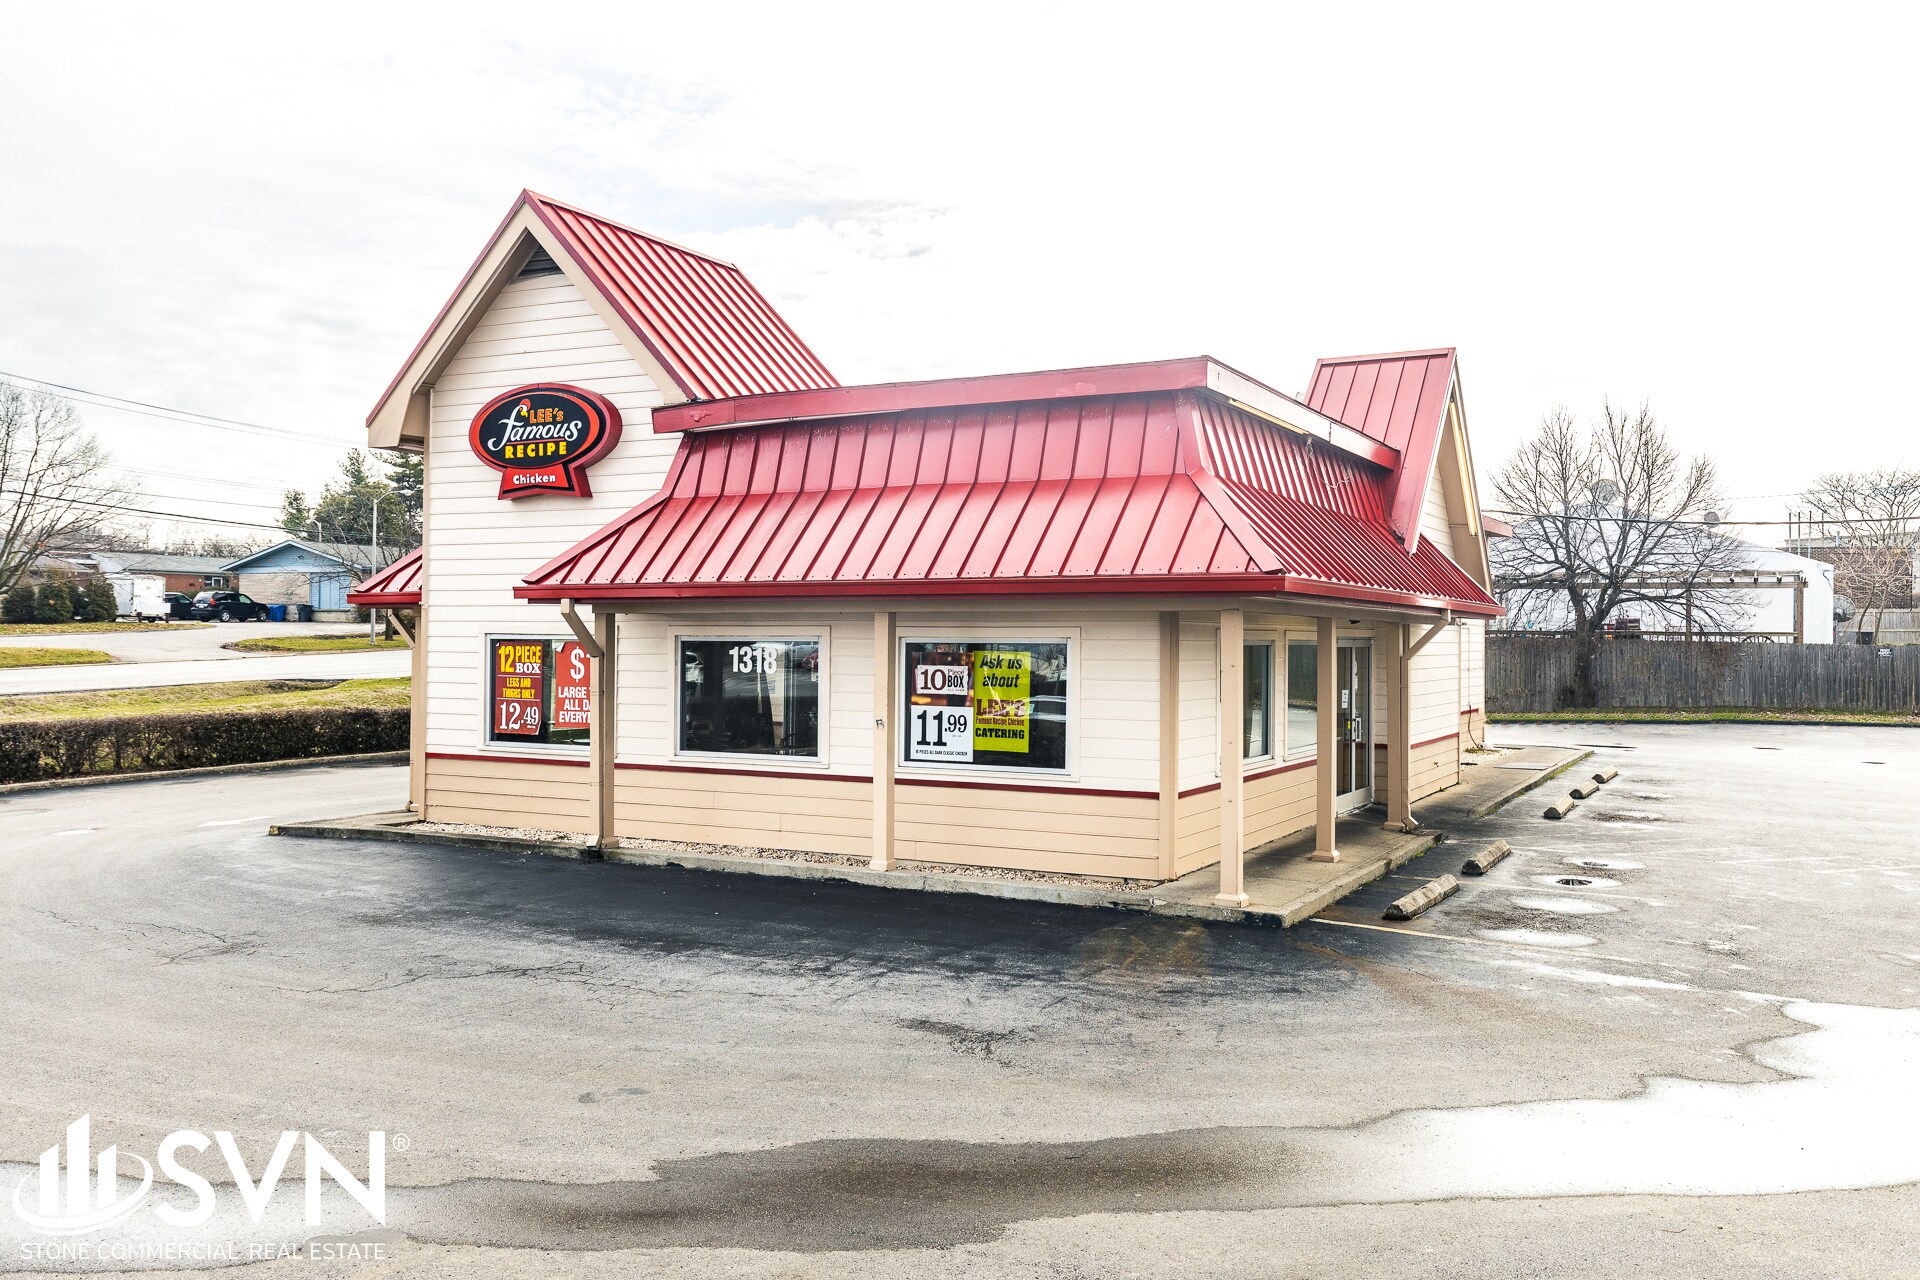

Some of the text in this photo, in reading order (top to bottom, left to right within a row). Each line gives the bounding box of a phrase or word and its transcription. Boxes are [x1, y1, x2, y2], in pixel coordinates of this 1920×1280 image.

[505, 442, 567, 459] RECIPE
[513, 473, 556, 485] Chicken
[498, 645, 542, 673] 12 PIECE
[729, 645, 777, 674] 1318
[979, 654, 1023, 670] Ask us
[515, 662, 541, 674] BOX
[506, 677, 532, 688] LEGS AND
[920, 669, 947, 691] 10
[947, 675, 965, 688] BOX
[982, 672, 1020, 688] about
[521, 689, 536, 699] ONLY
[558, 686, 588, 698] LARGE
[563, 699, 590, 711] ALL D
[976, 698, 1026, 717] LEE'S
[499, 701, 539, 730] 12.49
[976, 716, 1025, 726] Famous Recipe Chicken
[916, 709, 967, 747] 11.99
[975, 727, 1025, 740] CATERING
